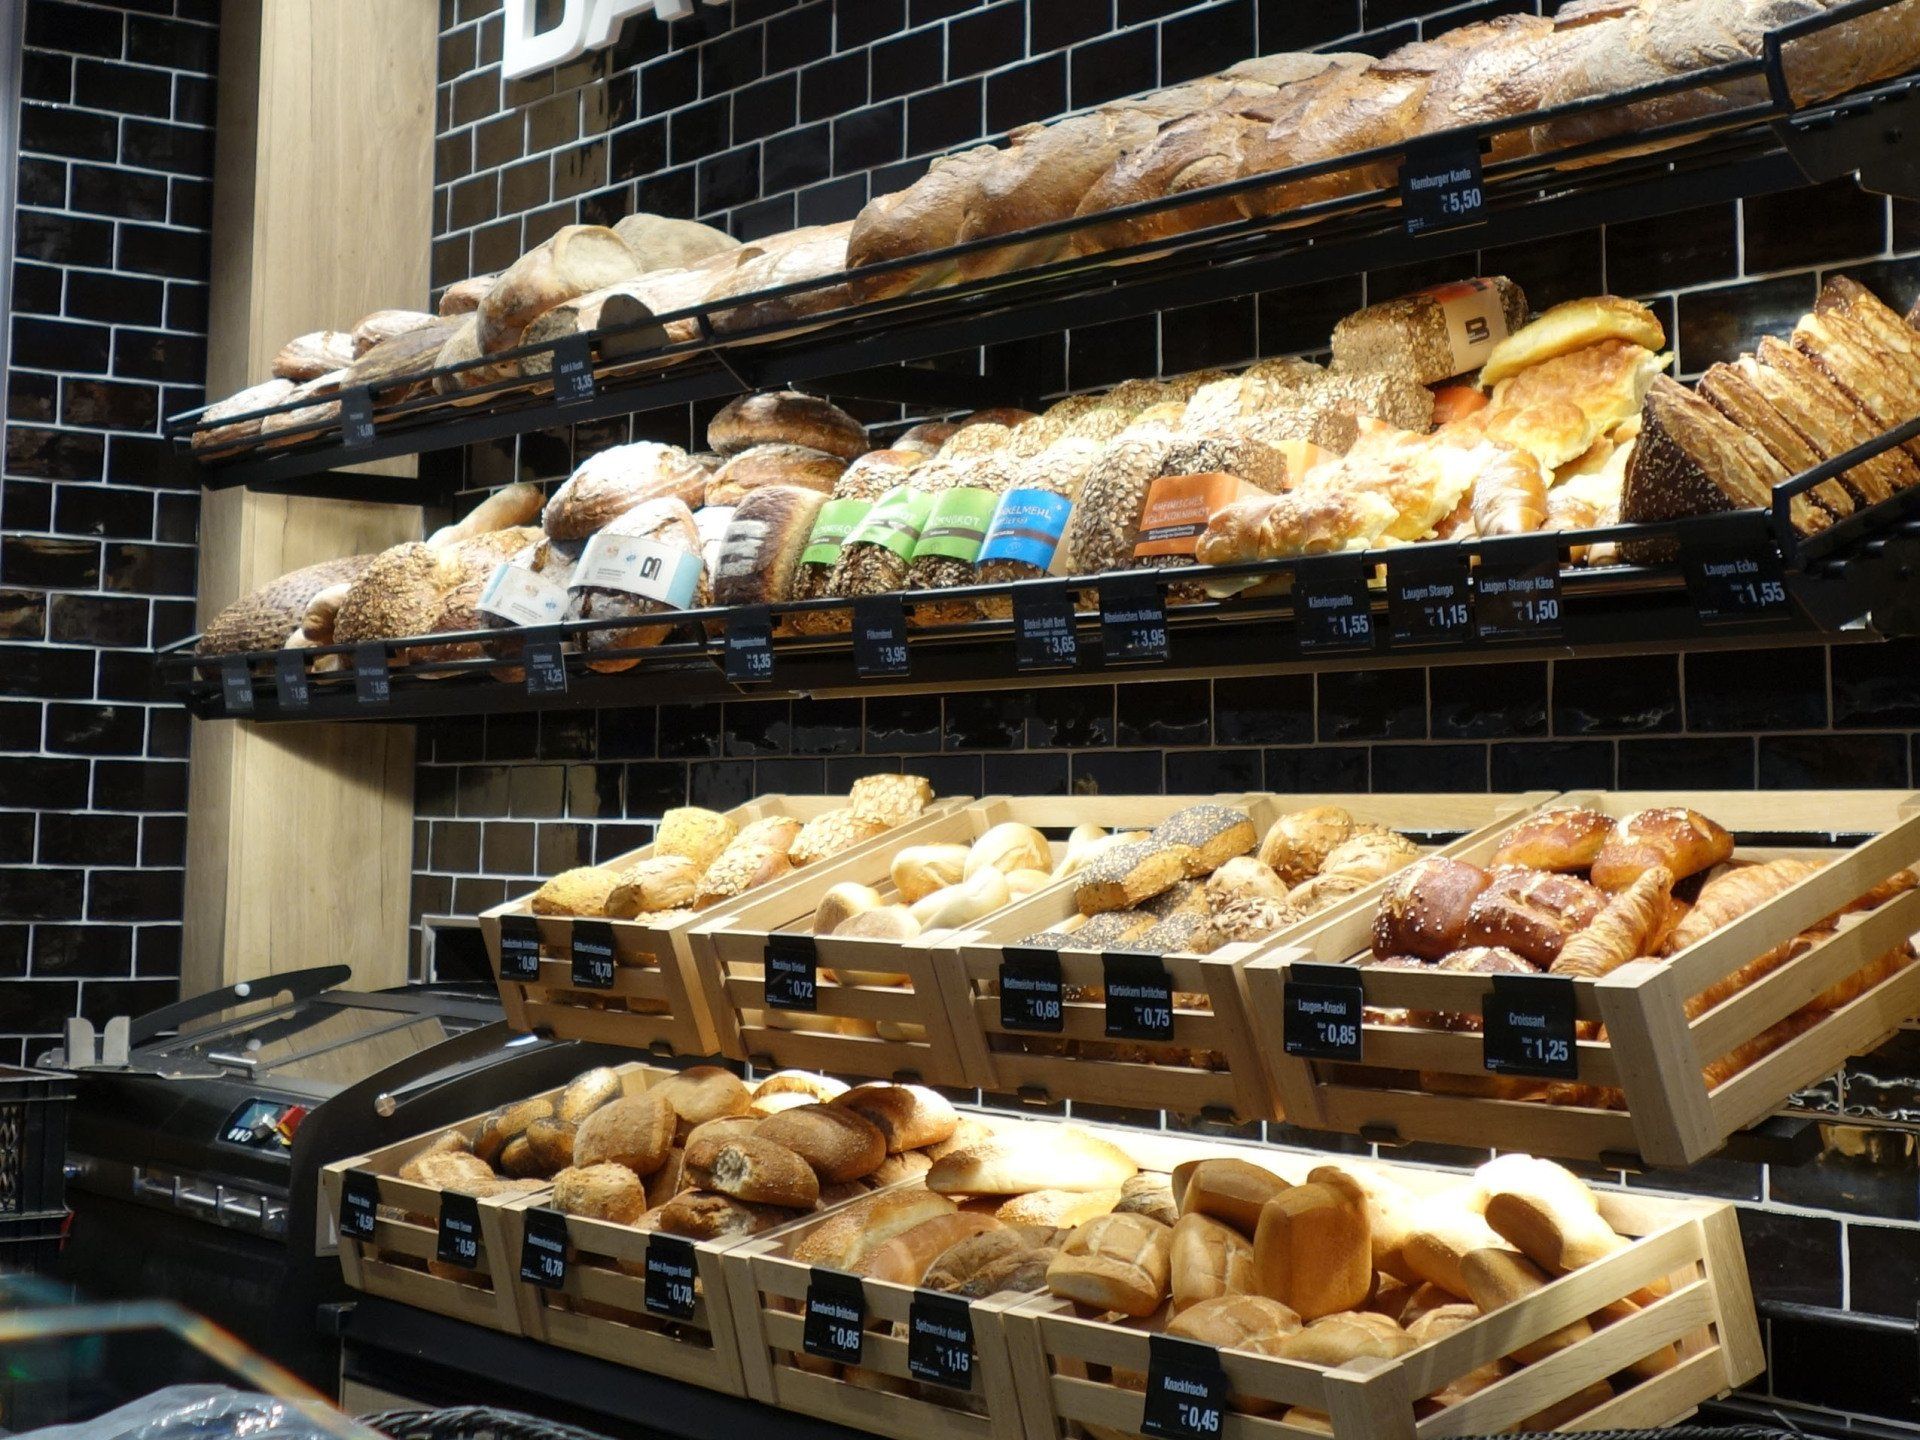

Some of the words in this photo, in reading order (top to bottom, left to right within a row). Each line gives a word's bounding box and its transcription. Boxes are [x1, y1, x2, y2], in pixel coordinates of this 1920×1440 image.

[1410, 172, 1450, 191] Hamburger
[1450, 168, 1472, 184] Kante
[1450, 188, 1482, 214] 5,50
[1703, 563, 1736, 577] Laugen
[1737, 560, 1759, 573] Ecke
[1402, 587, 1428, 602] Laugen
[1428, 584, 1454, 599] Stange
[1479, 580, 1507, 595] Laugen
[1507, 578, 1534, 593] Stange
[1535, 576, 1555, 590] Käse
[1746, 581, 1786, 607] 1,55
[1436, 604, 1468, 629] 1,15
[1525, 599, 1559, 624] 1,50
[1340, 614, 1370, 638] 1,55
[1051, 636, 1076, 656] 3,65
[1140, 629, 1166, 650] 3,95
[752, 653, 772, 671] 3,35
[885, 646, 907, 665] 3,95
[594, 961, 612, 978] 0,78
[793, 980, 813, 999] 0,72
[1141, 986, 1168, 999] Brötchen
[1035, 1000, 1060, 1020] 0,68
[1144, 1007, 1170, 1029] 0,75
[1298, 999, 1347, 1016] Laugen-Knacki
[1508, 1012, 1546, 1028] Croissant
[1328, 1024, 1356, 1047] 0,85
[1535, 1038, 1569, 1063] 1,25
[545, 1257, 563, 1277] 0,78
[837, 1327, 859, 1350] 0,85
[947, 1349, 969, 1373] 1,15
[1164, 1376, 1208, 1398] Knackfrische
[1189, 1406, 1219, 1432] 0,45
